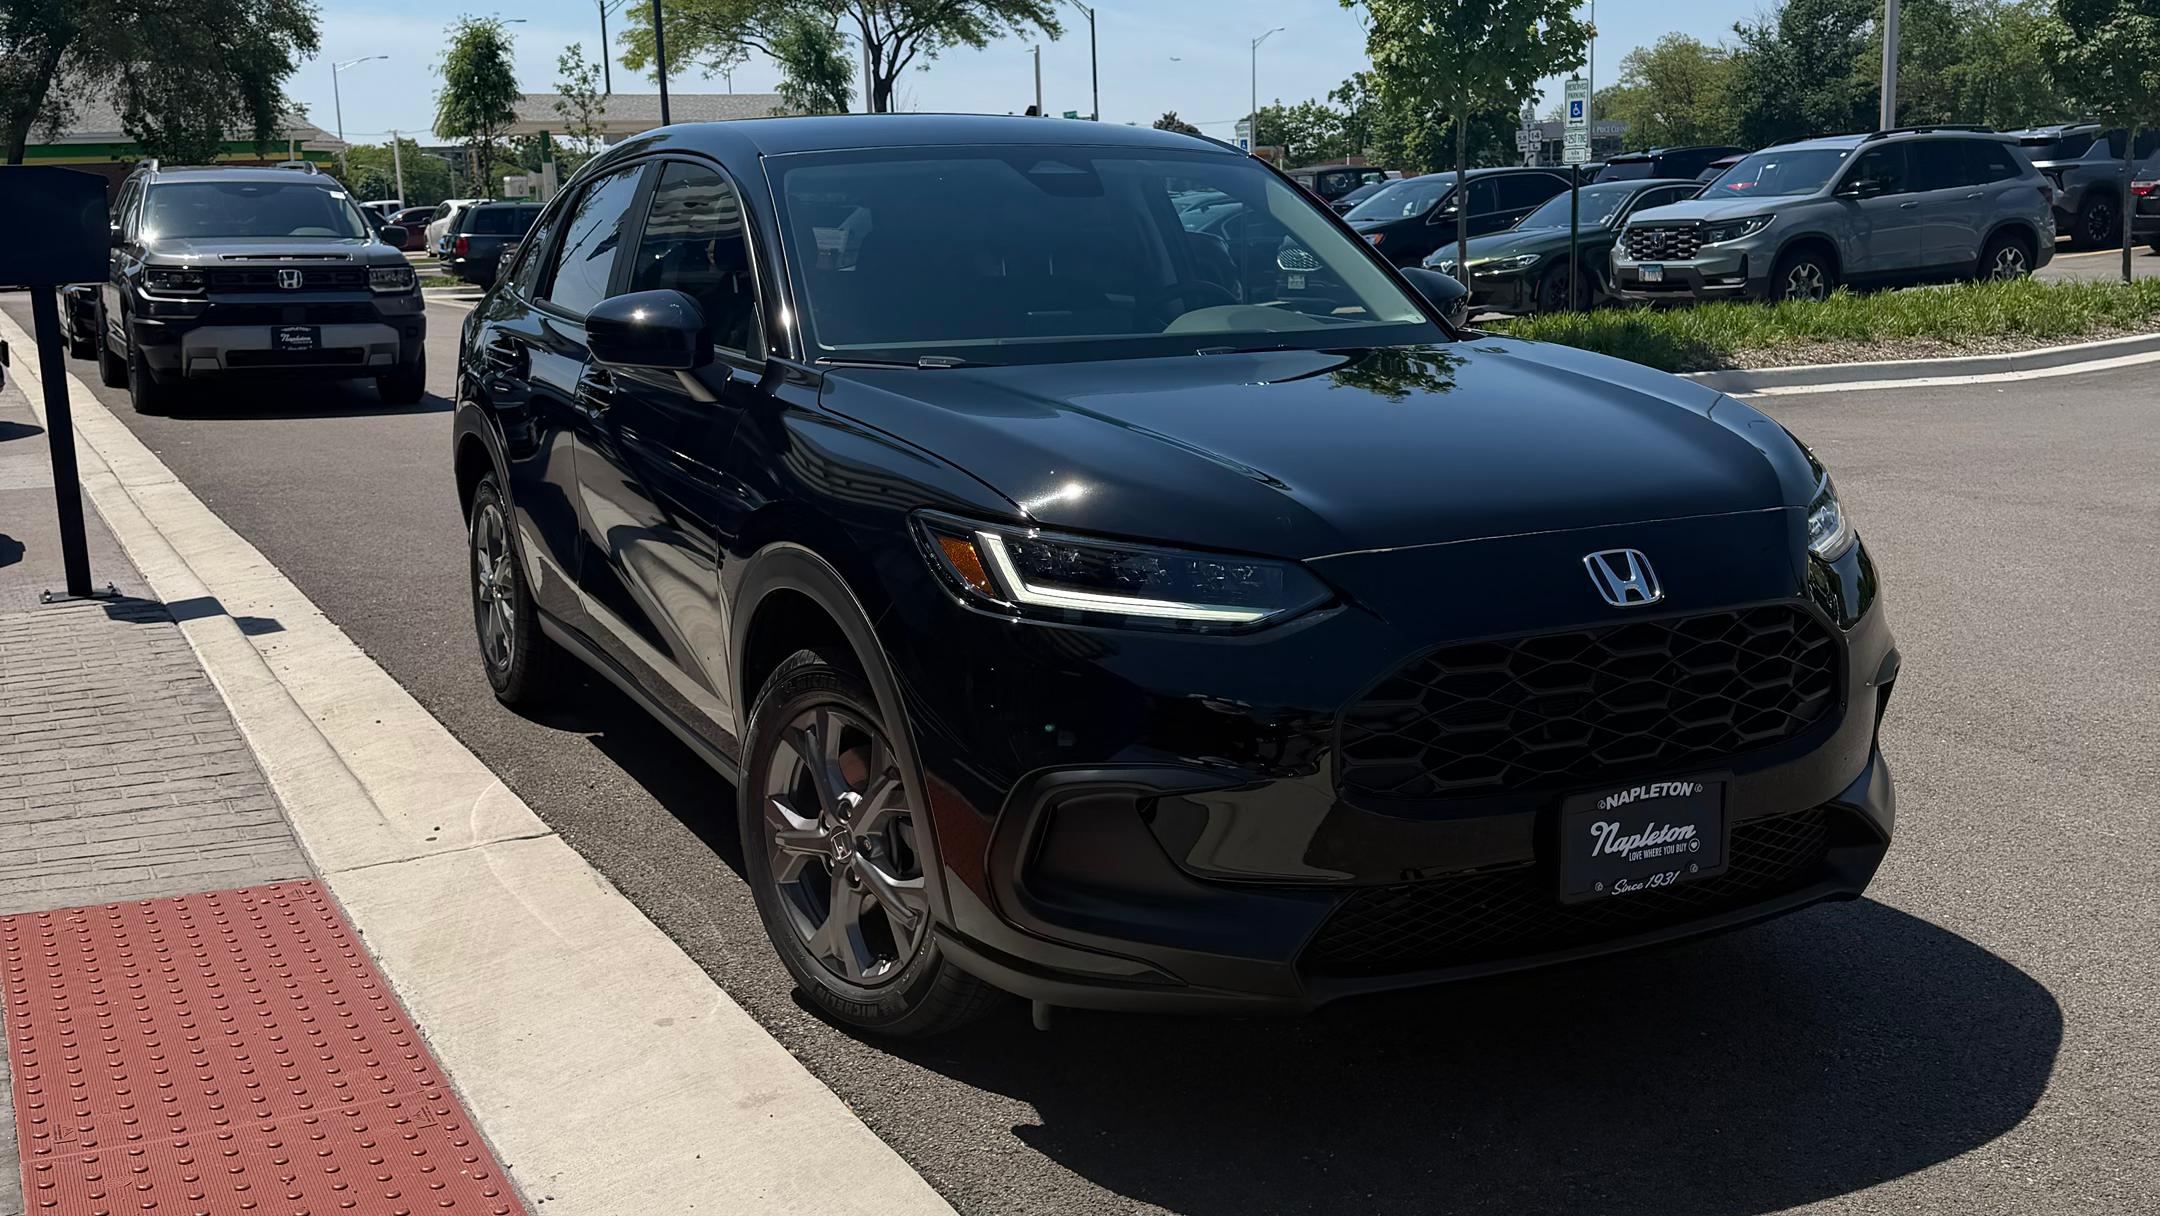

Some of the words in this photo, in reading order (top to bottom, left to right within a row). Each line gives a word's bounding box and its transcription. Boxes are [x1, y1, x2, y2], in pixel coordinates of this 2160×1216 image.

[1531, 132, 1540, 140] 14
[1605, 781, 1694, 810] NAPLETON
[1590, 821, 1697, 858] Napleton
[1628, 851, 1643, 862] LOVE
[1643, 847, 1663, 860] WHERE
[1663, 844, 1675, 856] YOU
[1676, 842, 1688, 854] BUY
[1611, 878, 1644, 896] Since
[1644, 870, 1681, 890] 1931
